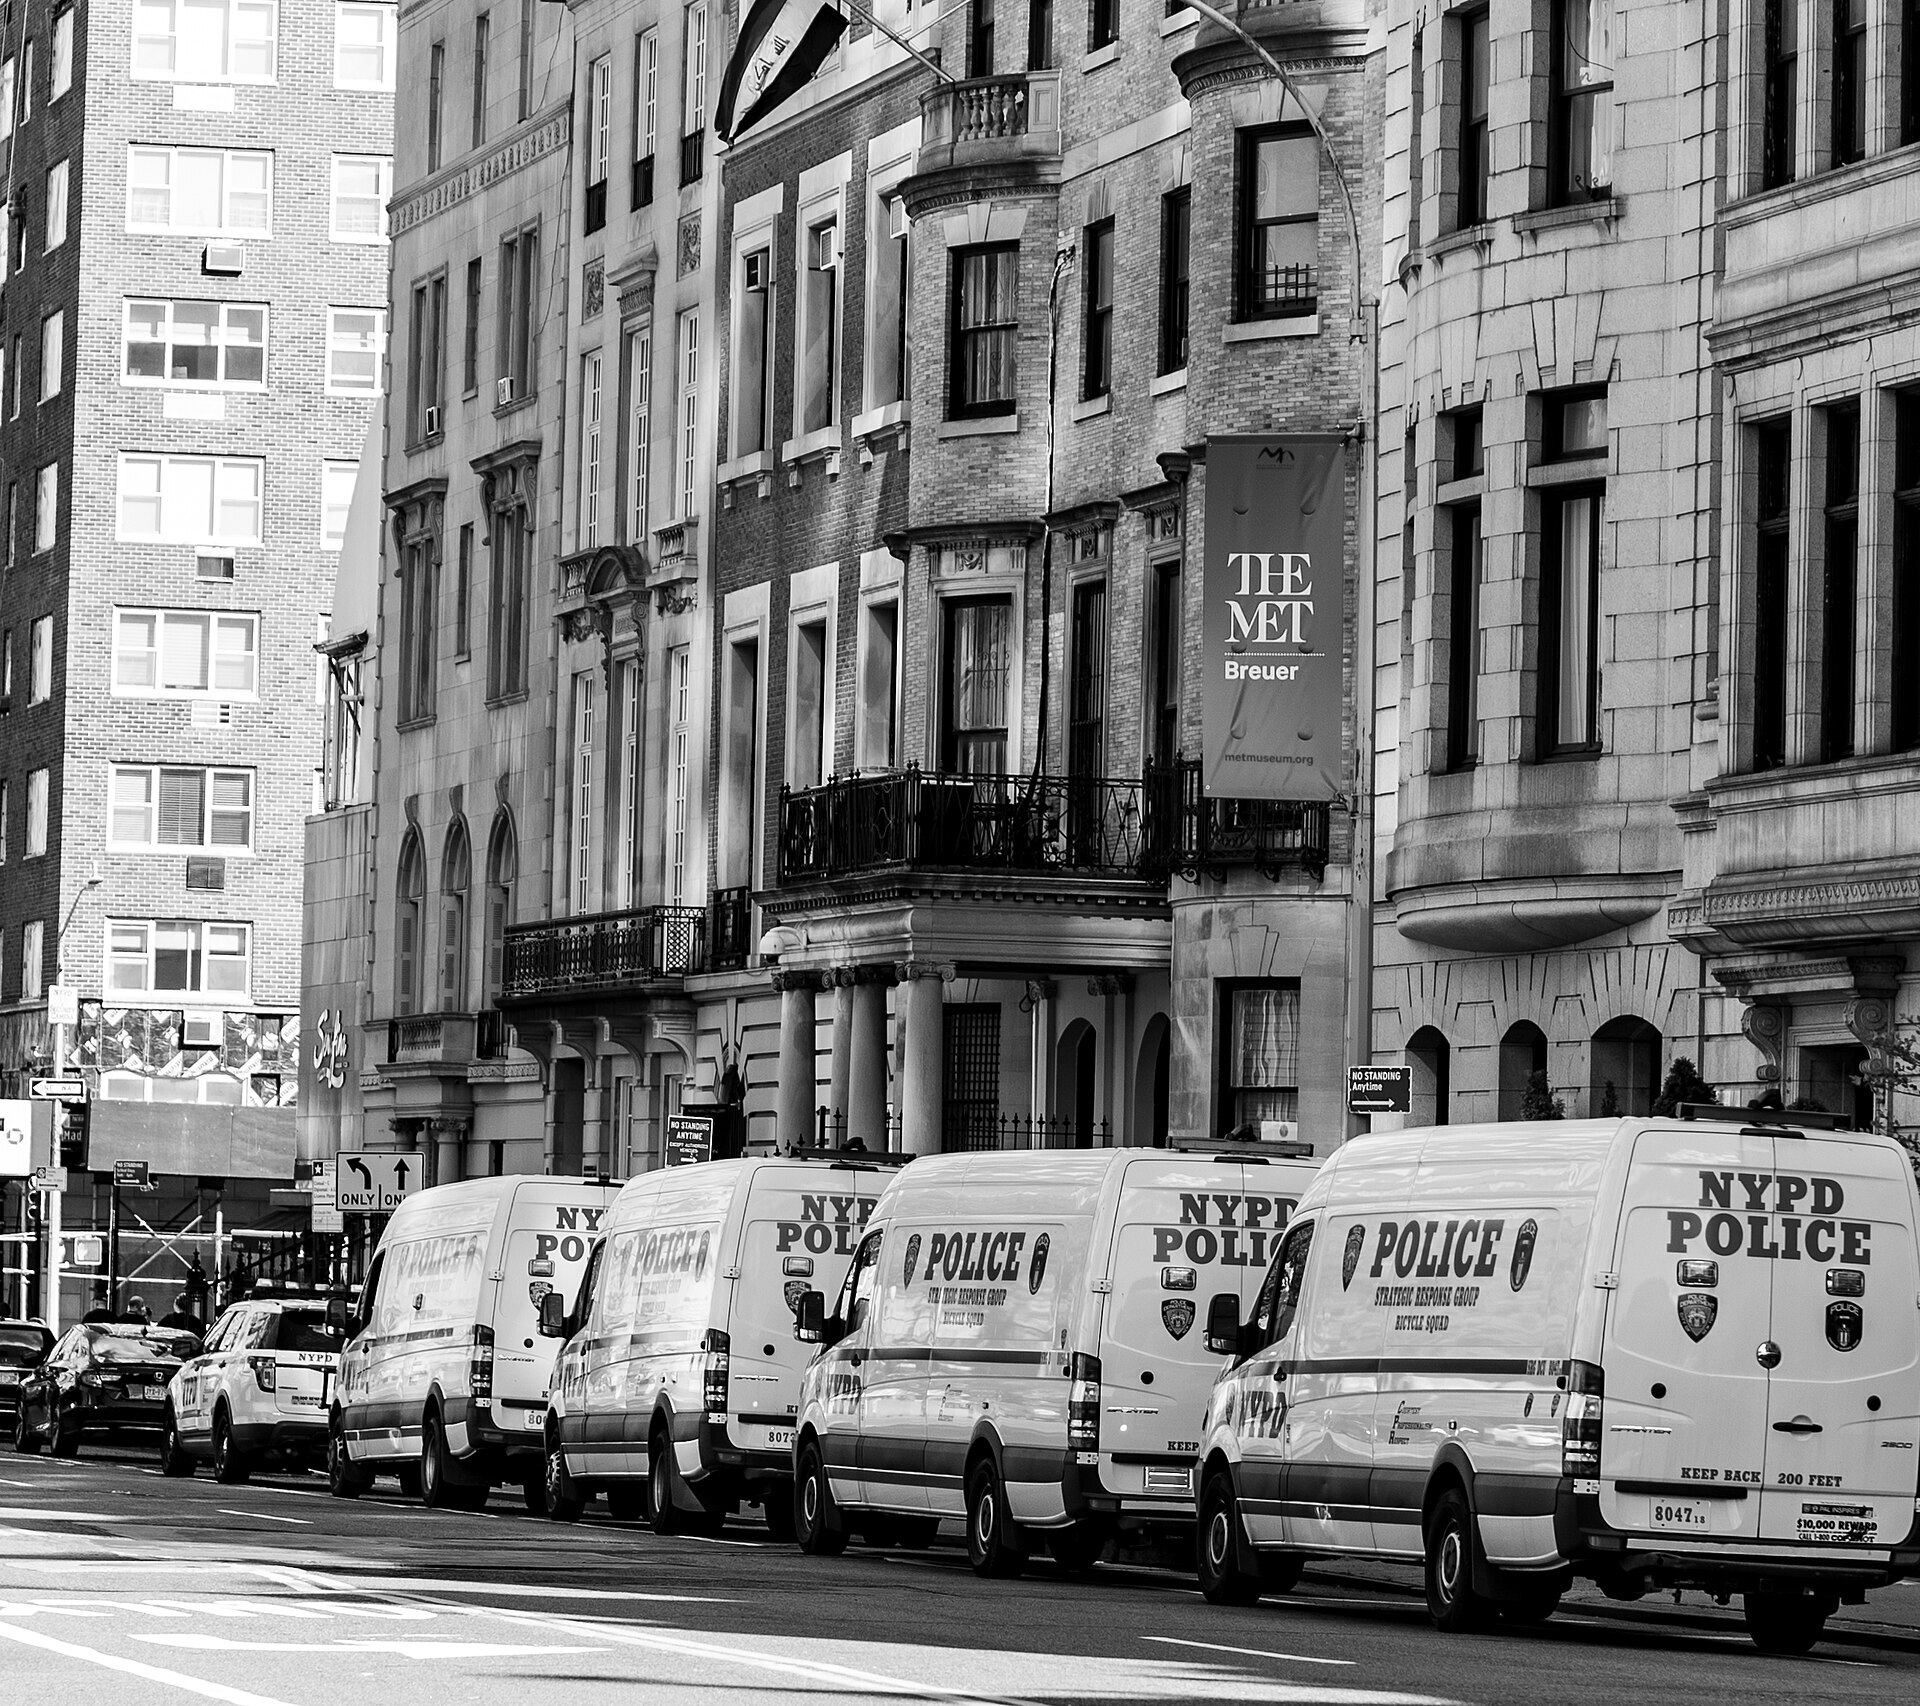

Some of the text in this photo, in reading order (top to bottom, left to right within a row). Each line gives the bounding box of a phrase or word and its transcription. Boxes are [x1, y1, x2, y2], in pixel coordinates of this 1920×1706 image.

[1227, 553, 1313, 595] THE
[1224, 600, 1315, 643] MET
[1224, 660, 1299, 680] Breuer
[1224, 753, 1314, 766] metmuseum.org
[1352, 1071, 1401, 1080] NO STANDING
[1352, 1082, 1383, 1093] Anytime
[670, 1121, 710, 1131] NO STANDING
[676, 1131, 703, 1141] ANYTIME
[341, 1193, 375, 1206] ONLY
[384, 1194, 407, 1206] ON
[1698, 1170, 1844, 1215] NYPD
[556, 1206, 608, 1231] NY
[801, 1194, 879, 1224] NYP
[1179, 1193, 1301, 1228] NYPD
[1153, 1227, 1285, 1267] POLI
[1666, 1211, 1872, 1265] POLICE
[631, 1229, 697, 1277] POLICE
[923, 1231, 1026, 1281] POLICE
[1369, 1219, 1505, 1279] POLICE
[1374, 1286, 1480, 1306] STRATEGIC RESPONSE GROUP
[1830, 1303, 1859, 1317] POLICE
[1394, 1315, 1450, 1334] BICYCLE SQUAD
[298, 1353, 333, 1362] NYPD
[1167, 1440, 1199, 1451] KEEP
[1880, 1441, 1914, 1449] 2500
[1680, 1467, 1843, 1487] KEEP BACK 200 FEET
[1655, 1506, 1693, 1524] 8047
[1796, 1518, 1878, 1531] $10,000 REWARD
